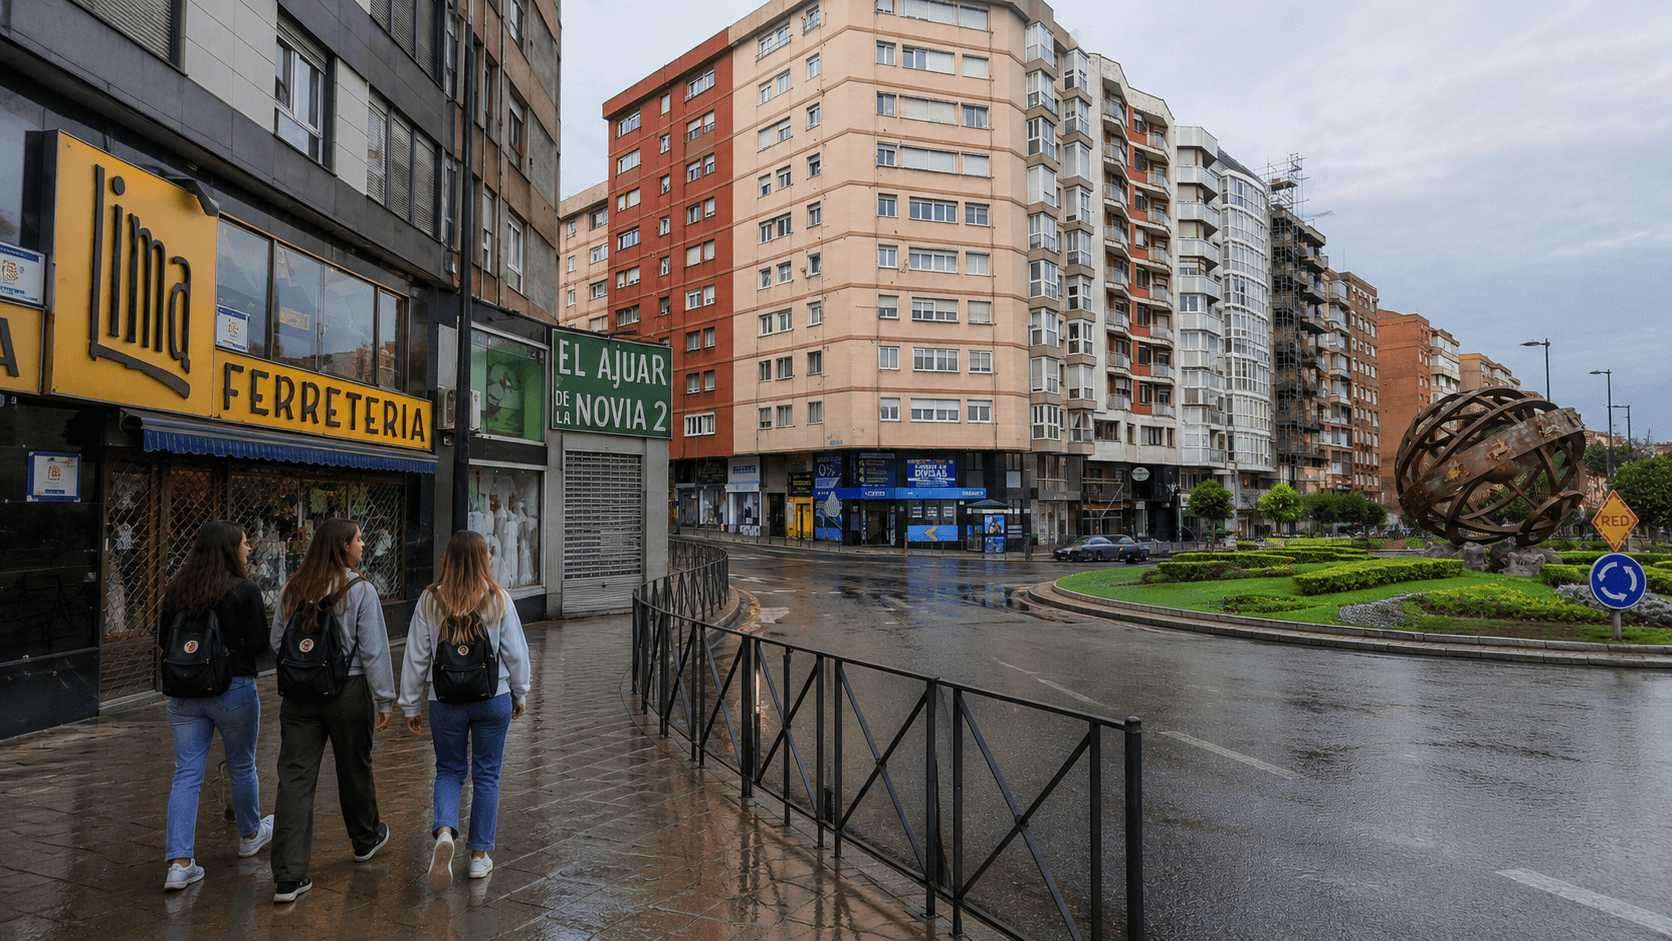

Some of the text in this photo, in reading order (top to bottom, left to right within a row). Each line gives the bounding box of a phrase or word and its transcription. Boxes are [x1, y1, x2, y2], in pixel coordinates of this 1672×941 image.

[559, 339, 586, 377] EL
[223, 362, 425, 442] FERRETERIA
[555, 390, 570, 407] DE
[556, 411, 571, 425] LA
[576, 393, 667, 432] NOVIA 2
[1601, 515, 1630, 527] RED
